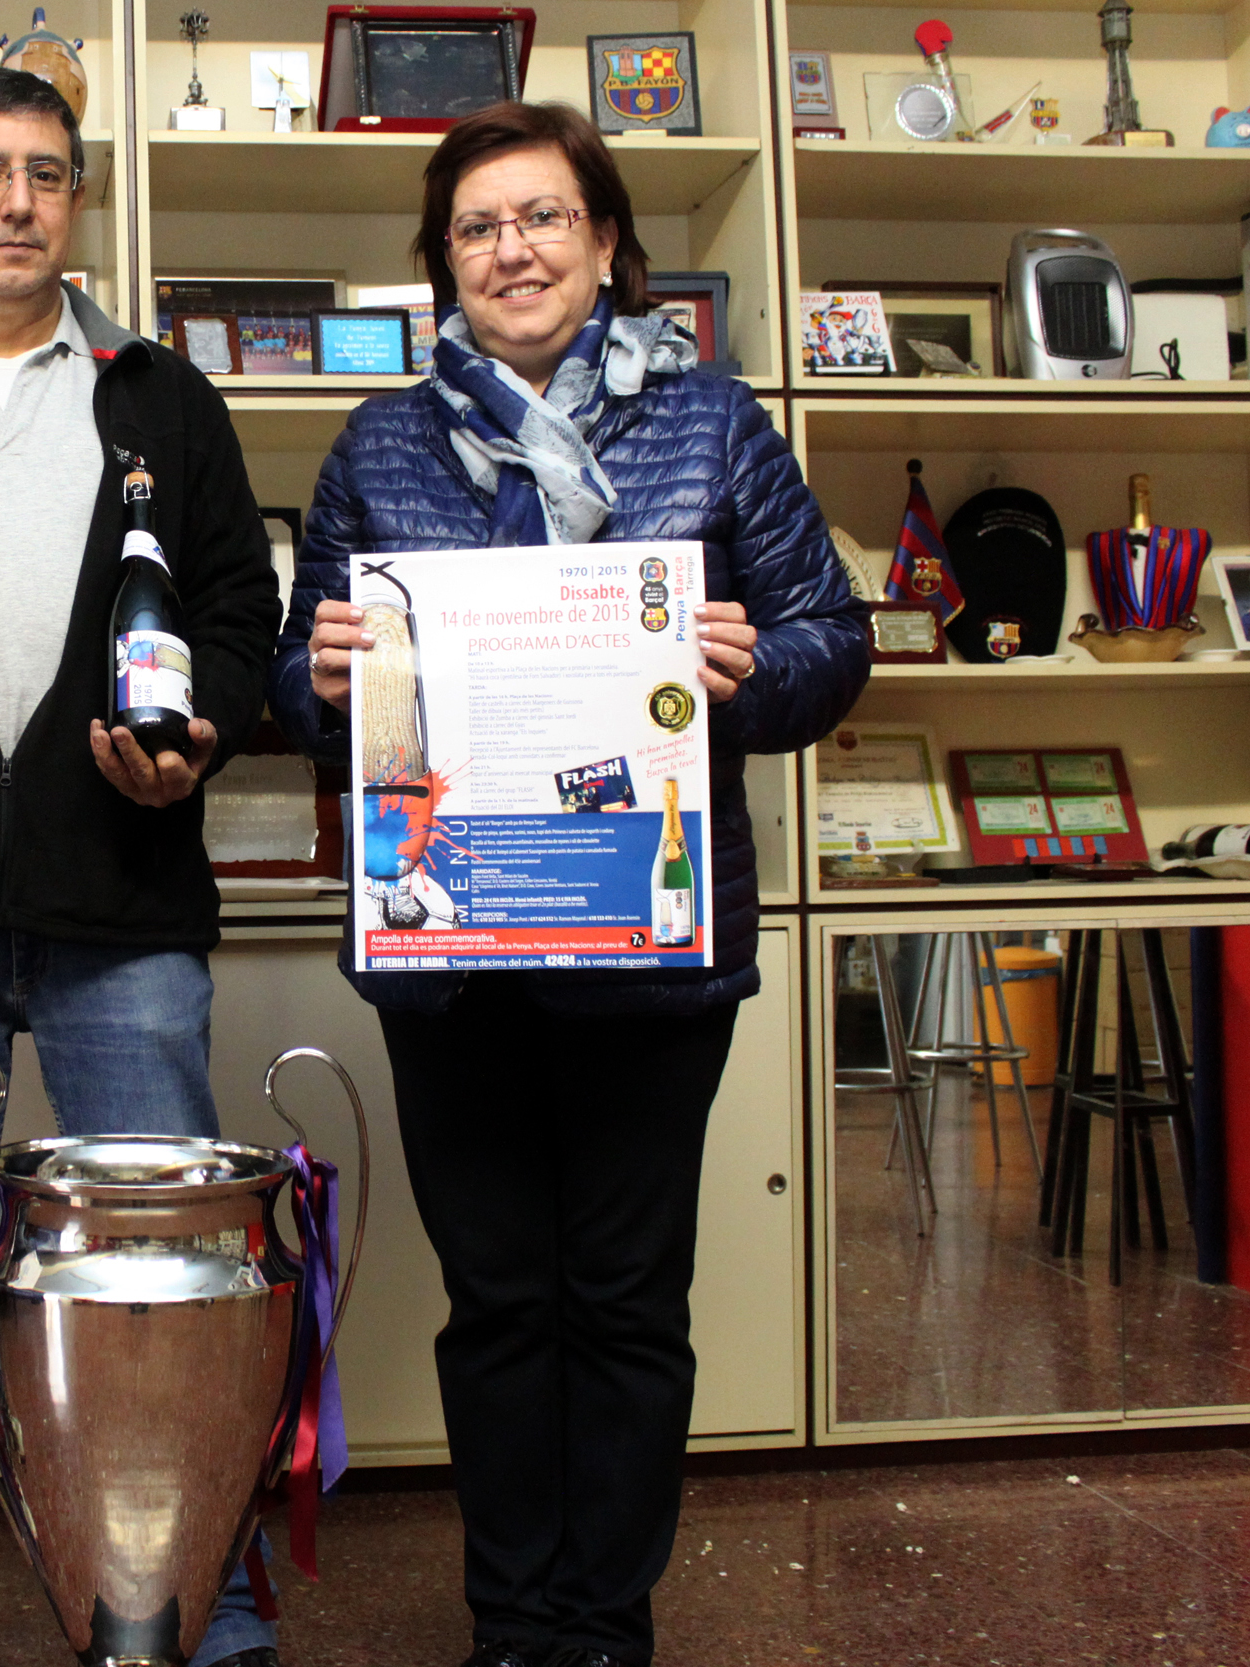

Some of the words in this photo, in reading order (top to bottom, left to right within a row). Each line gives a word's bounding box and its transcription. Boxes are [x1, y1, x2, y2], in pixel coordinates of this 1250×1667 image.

[559, 567, 588, 578] 1970
[597, 566, 627, 576] 2015
[674, 556, 685, 595] Barça
[560, 584, 630, 601] Dissabte,
[440, 611, 458, 628] 14
[462, 609, 481, 626] de
[486, 606, 563, 626] novembre
[568, 604, 587, 622] de
[592, 603, 630, 622] 2015
[676, 600, 687, 641] Penya
[468, 636, 560, 652] PROGRAMA
[566, 633, 631, 649] D'ACTES
[636, 748, 646, 758] Hi
[647, 744, 661, 755] han
[663, 734, 695, 752] ampolles
[671, 762, 677, 771] la
[678, 755, 698, 768] teva!
[561, 759, 622, 789] FLASH
[1027, 803, 1039, 814] 24
[1104, 802, 1116, 814] 24
[371, 935, 402, 945] Ampolla
[403, 934, 413, 943] de
[434, 934, 497, 943] commemorativa.
[632, 934, 644, 946] 7€
[371, 958, 407, 968] LOTERIA
[408, 957, 419, 968] DE
[420, 957, 450, 968] NADAL.
[451, 959, 477, 968] Tenim
[478, 958, 506, 967] dècims
[508, 959, 522, 967] del
[523, 958, 544, 966] núm.
[545, 955, 576, 966] 42424
[583, 957, 590, 966] la
[618, 957, 661, 968] disposició.
